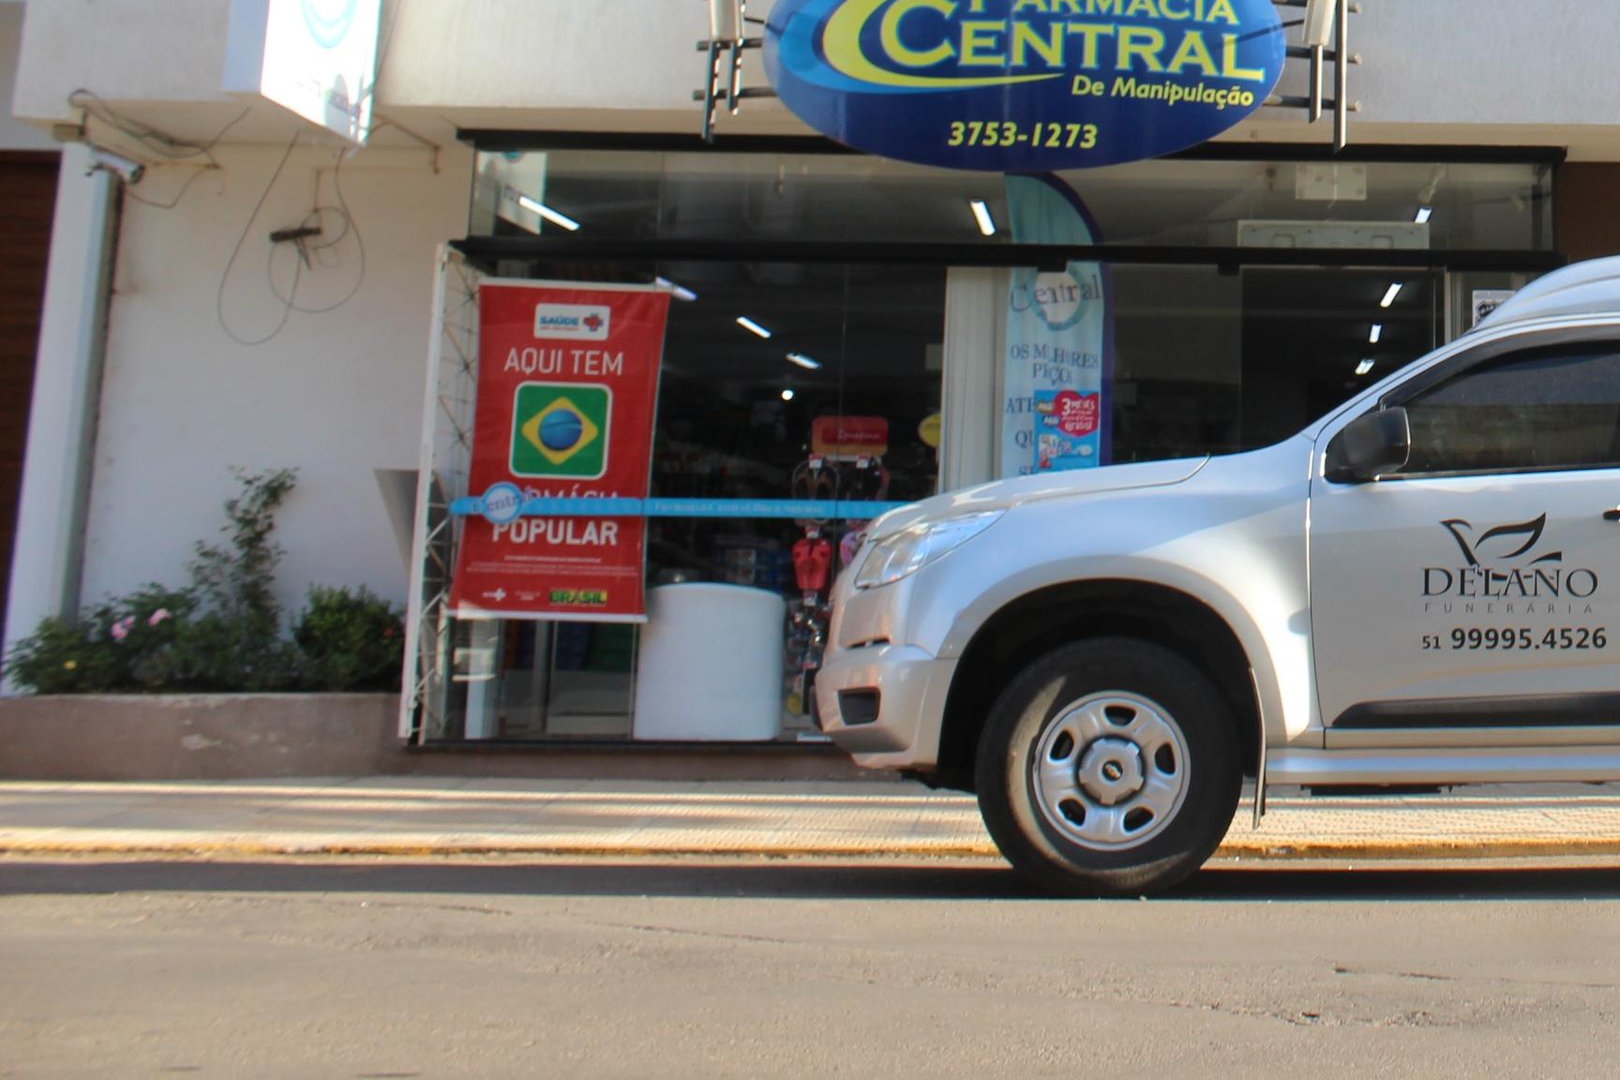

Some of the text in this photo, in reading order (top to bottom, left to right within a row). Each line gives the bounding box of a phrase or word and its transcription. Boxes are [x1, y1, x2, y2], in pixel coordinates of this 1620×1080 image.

[1072, 74, 1254, 108] De Manipulação
[947, 120, 1099, 149] 3753-1273
[504, 348, 624, 376] AQUI TEM
[492, 518, 619, 547] POPULAR
[1421, 567, 1598, 599] DELANO
[1422, 627, 1607, 650] 51 99995.4526
